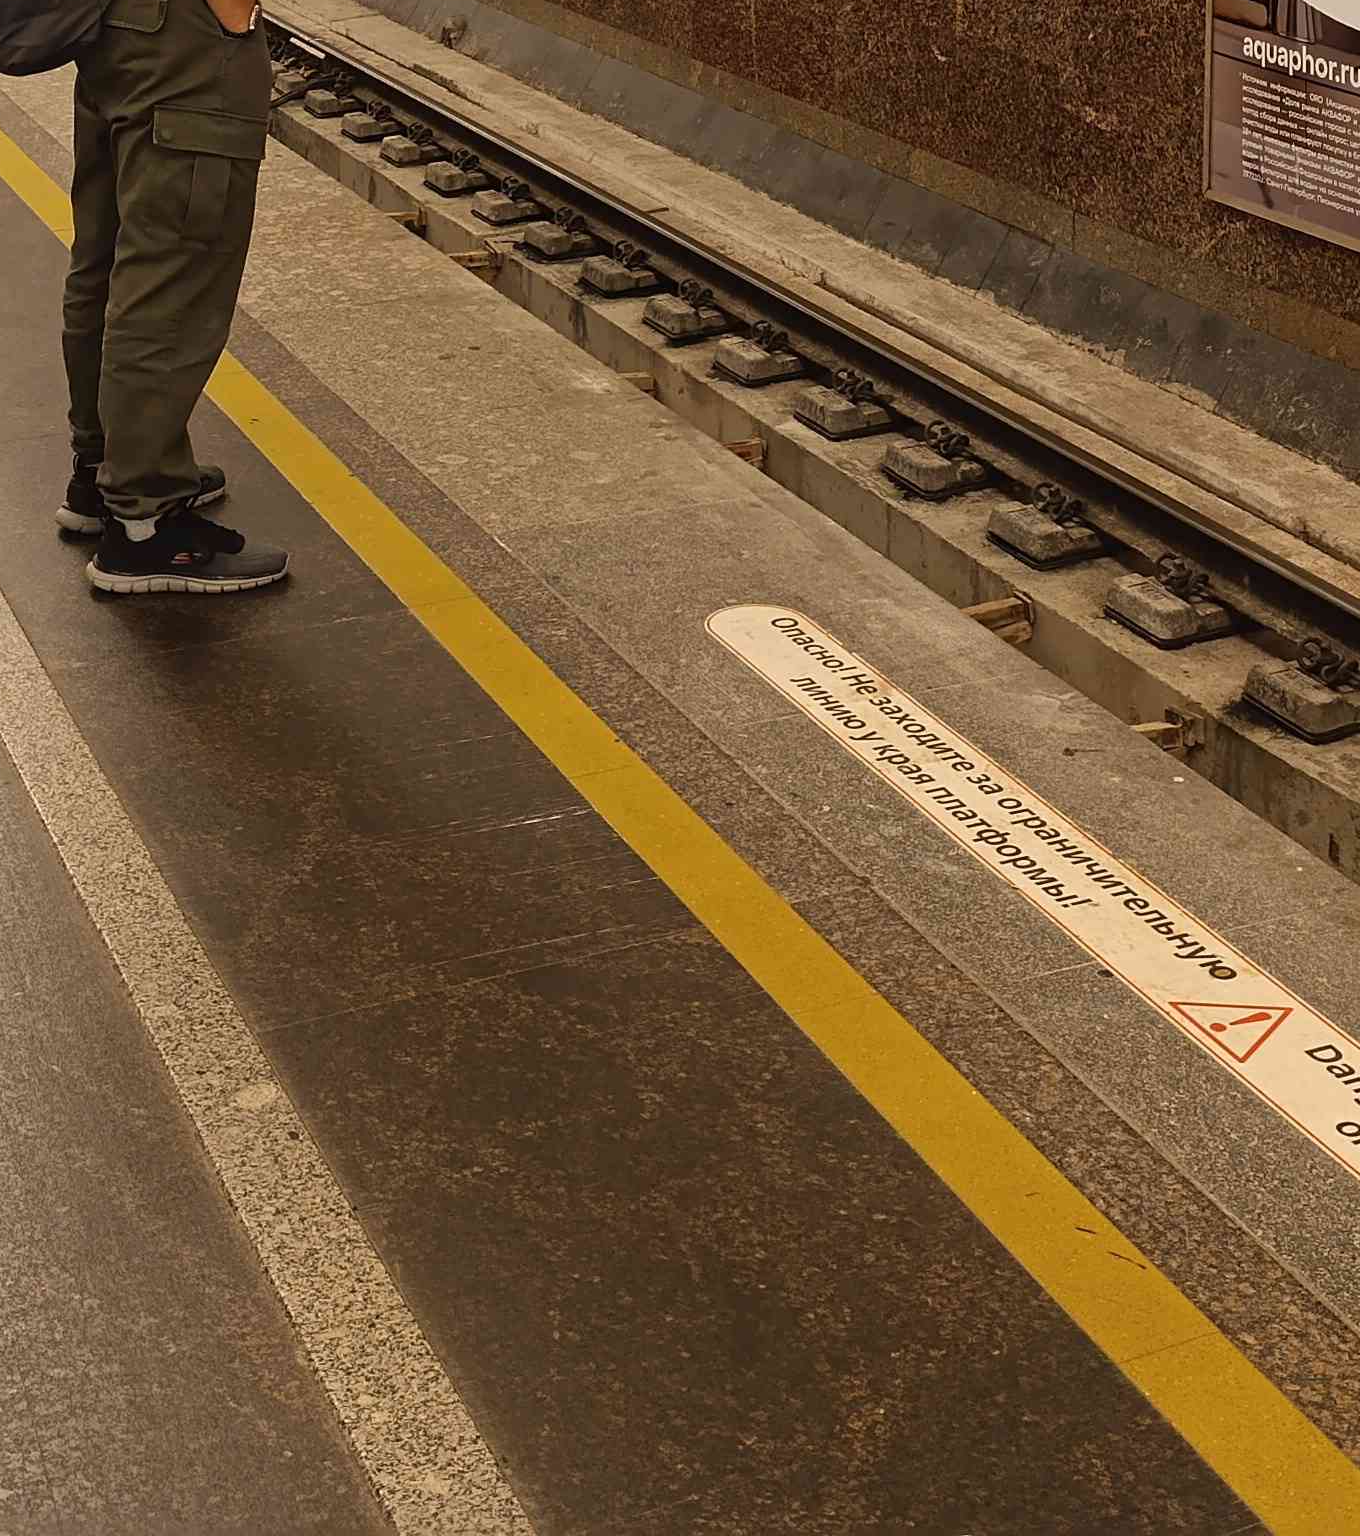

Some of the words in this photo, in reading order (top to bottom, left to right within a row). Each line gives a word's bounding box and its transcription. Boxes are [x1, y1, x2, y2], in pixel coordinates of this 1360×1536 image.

[771, 617, 857, 673] Опасно!
[840, 673, 878, 695] Не
[869, 696, 976, 772] заходите
[966, 773, 1004, 795] за
[997, 797, 1238, 981] ограничительную
[790, 676, 866, 730] линию
[849, 730, 885, 743] у
[873, 744, 936, 785] края
[925, 786, 1093, 908] платформы!
